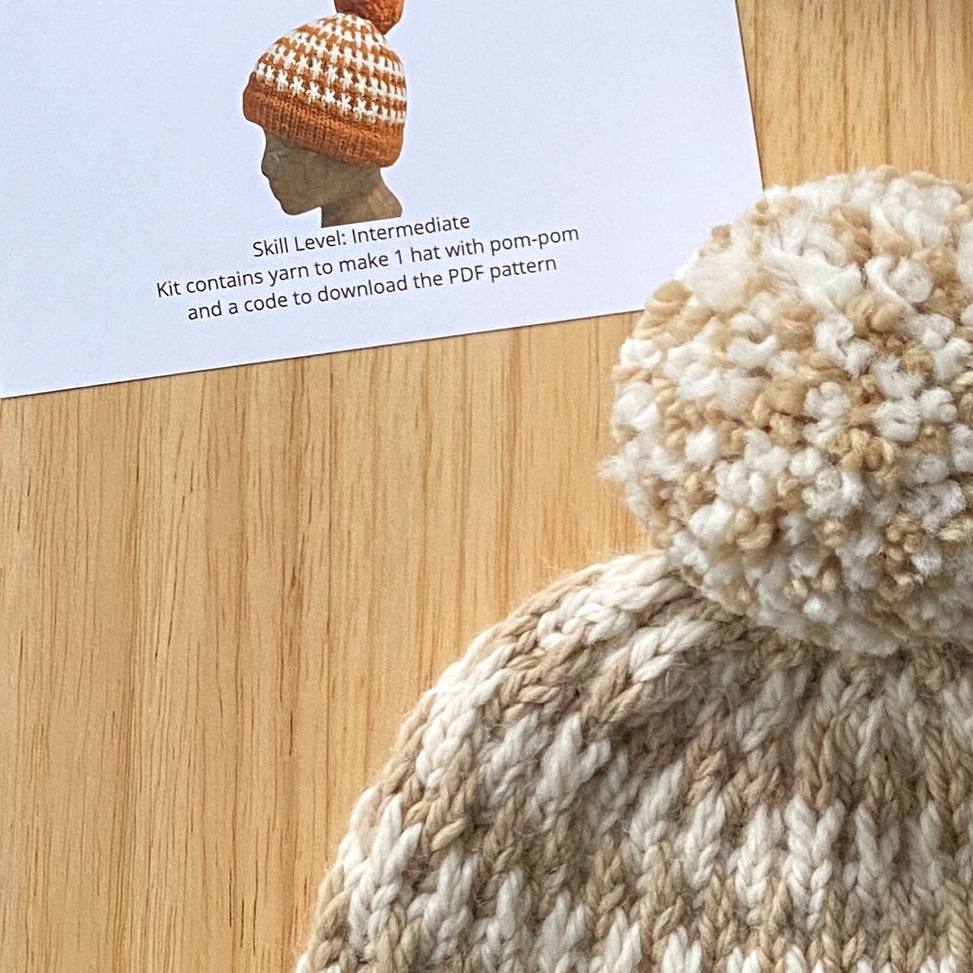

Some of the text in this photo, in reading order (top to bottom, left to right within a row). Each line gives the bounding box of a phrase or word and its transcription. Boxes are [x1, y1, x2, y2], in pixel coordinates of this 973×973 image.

[156, 228, 580, 298] Kit contains yarn to make 1 hat with pom-pom
[252, 216, 471, 258] Skill Level: Intermediate
[187, 258, 557, 321] and a code to download the PDF pattern
